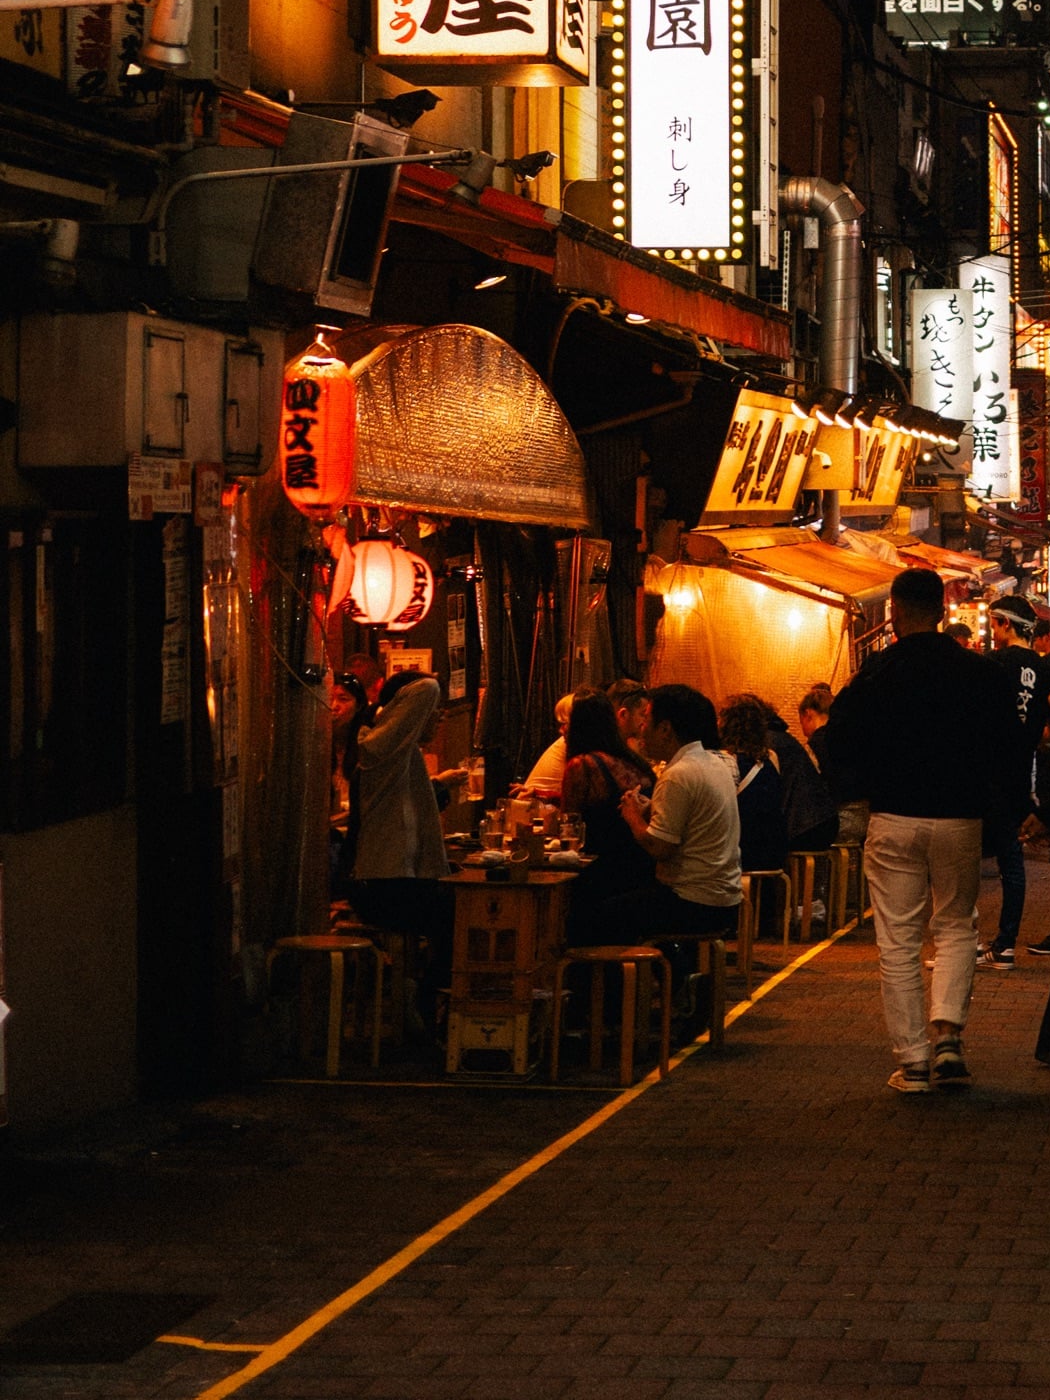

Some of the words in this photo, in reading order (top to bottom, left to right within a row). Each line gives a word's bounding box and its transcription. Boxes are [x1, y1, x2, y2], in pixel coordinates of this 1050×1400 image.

[667, 116, 692, 206] 刺し身
[972, 275, 995, 353] 牛タン
[284, 378, 321, 490] 四文屋
